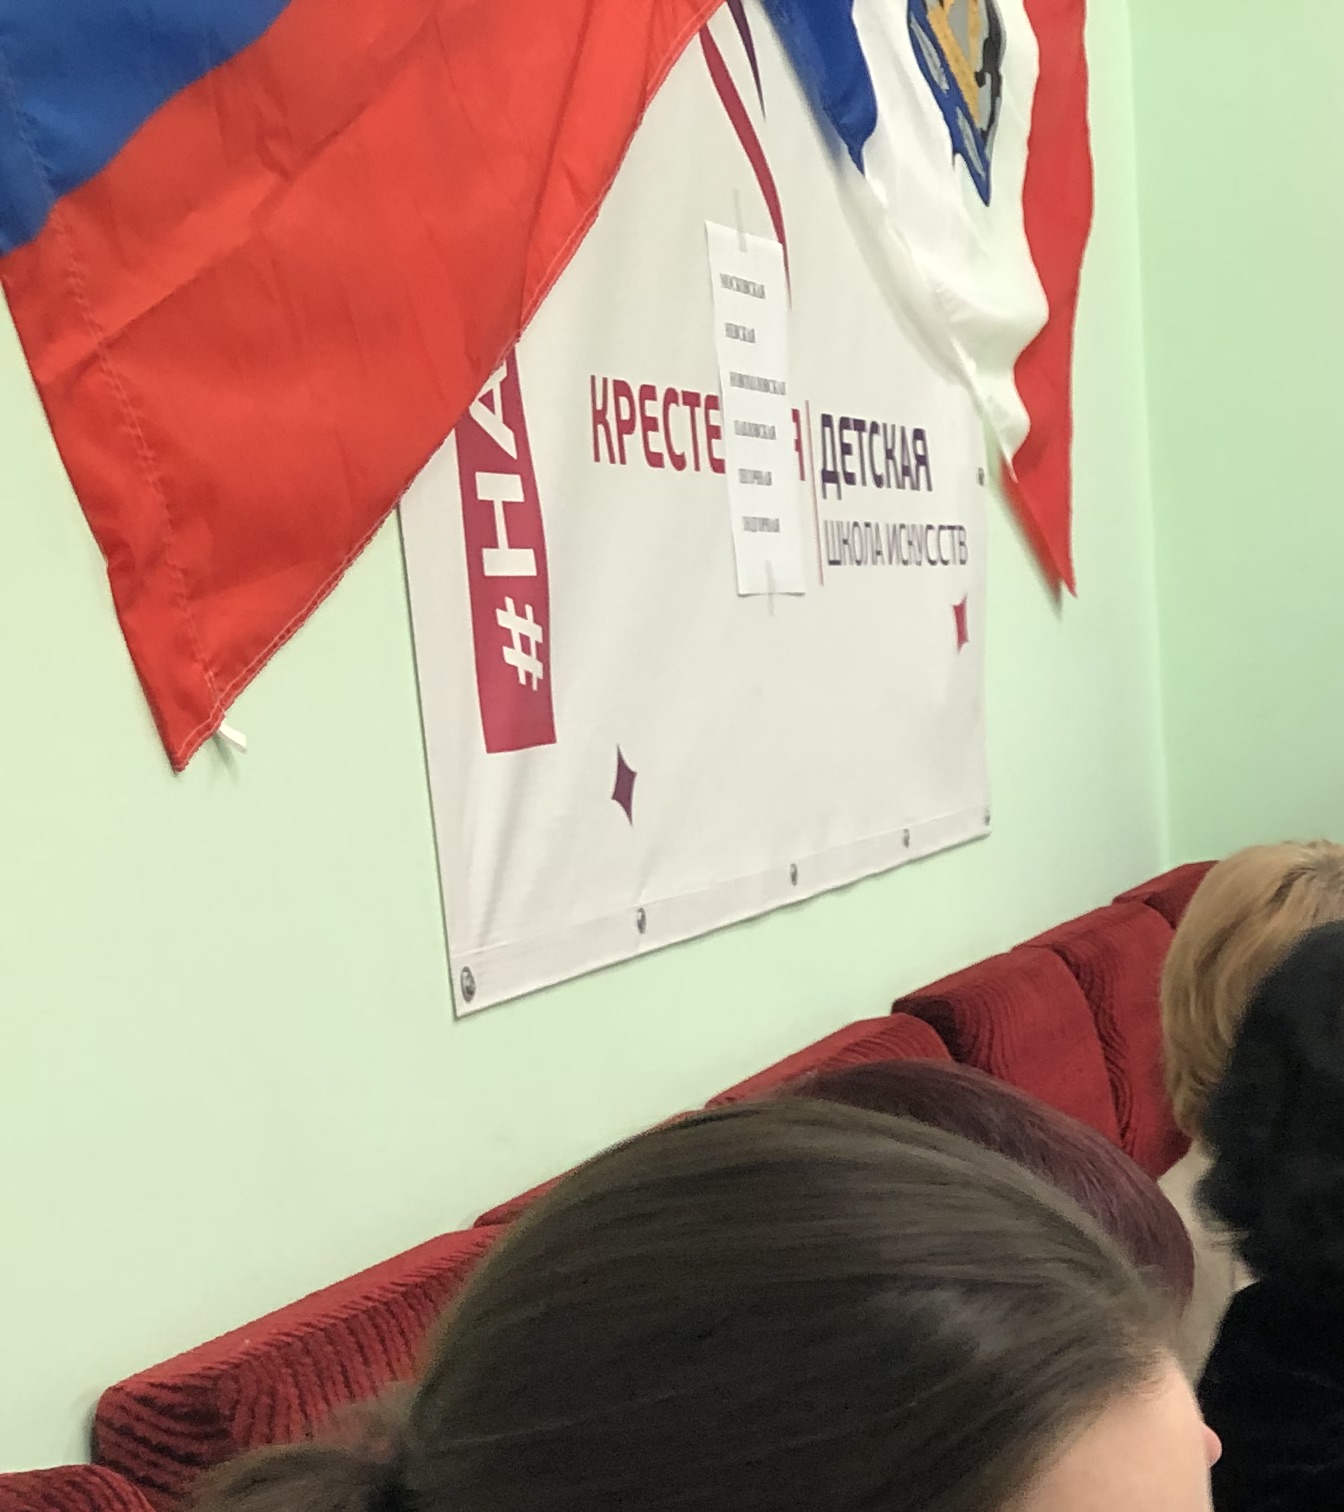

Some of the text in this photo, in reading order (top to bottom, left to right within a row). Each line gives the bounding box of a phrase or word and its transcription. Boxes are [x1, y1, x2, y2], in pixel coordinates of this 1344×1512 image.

[591, 374, 933, 500] КРЕСТЕЯ ДЕТСКАЯ
[824, 519, 968, 567] ШКОЛА ИСКУССТВ
